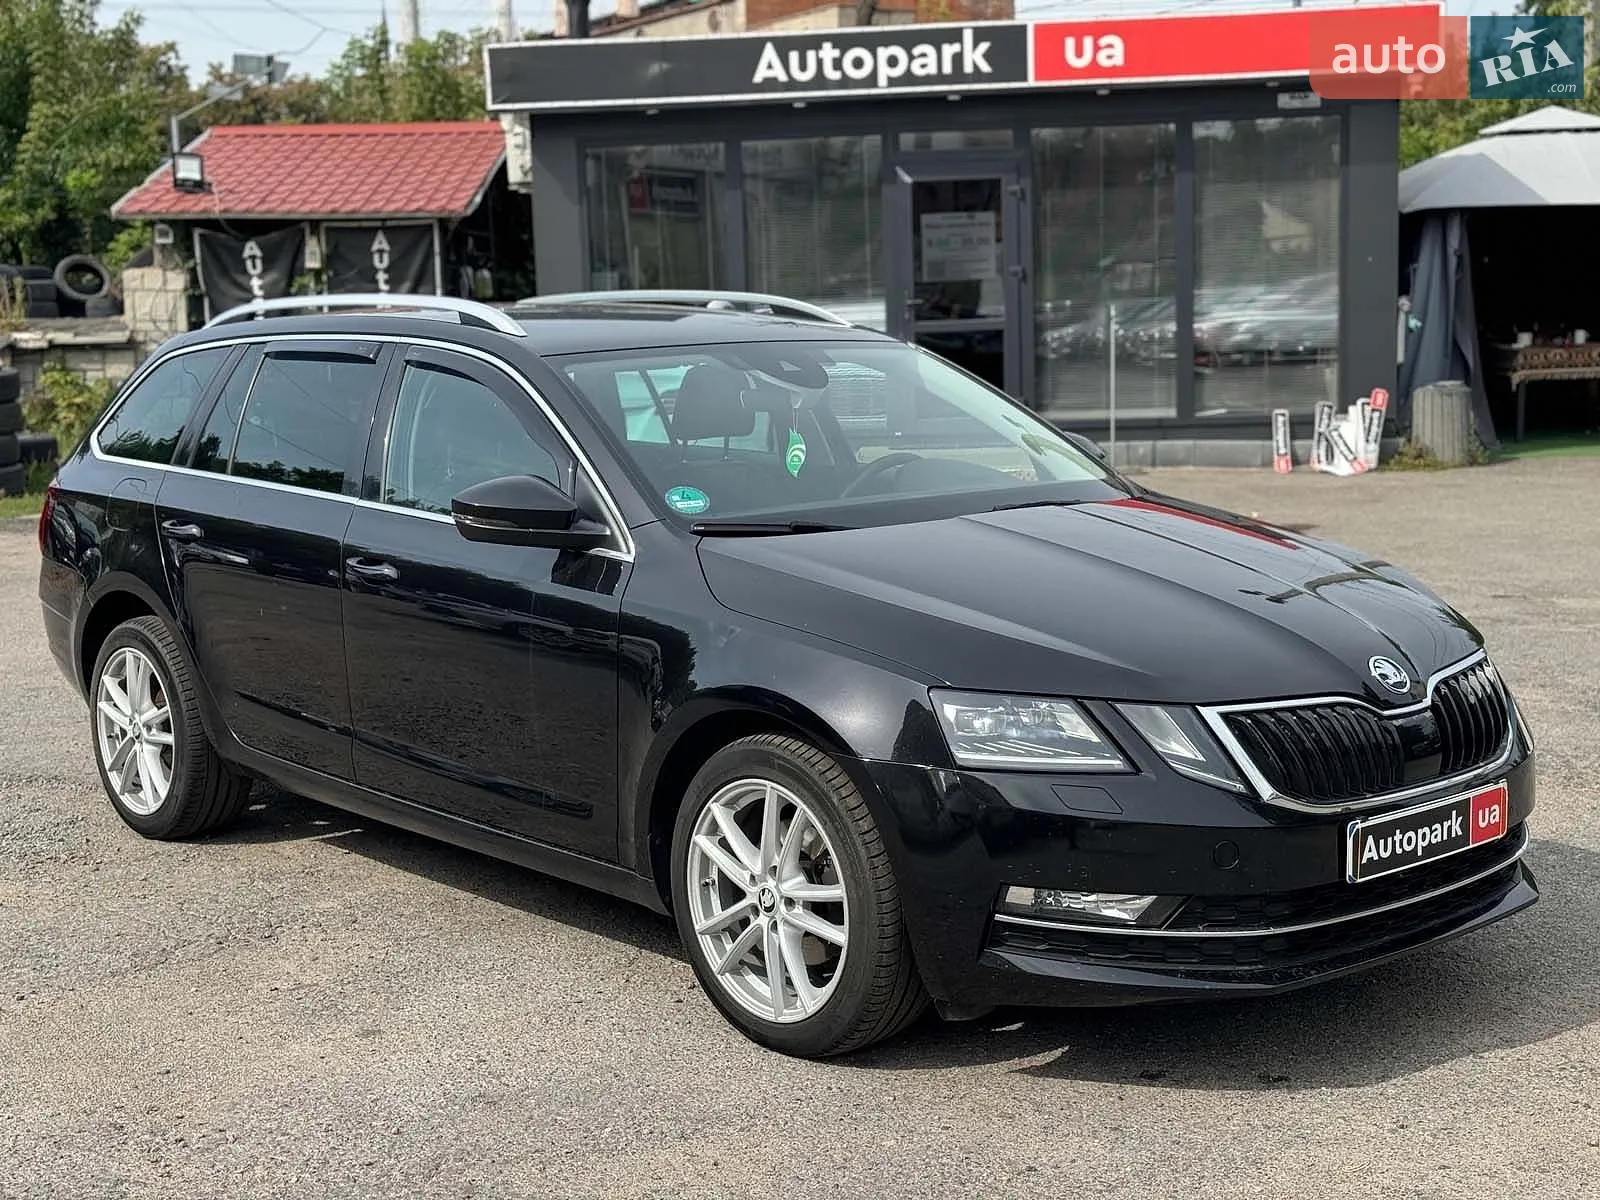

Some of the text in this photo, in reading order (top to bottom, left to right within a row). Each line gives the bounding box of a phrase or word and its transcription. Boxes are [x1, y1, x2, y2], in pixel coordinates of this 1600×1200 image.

[752, 28, 1125, 88] Autopark ua
[1361, 804, 1500, 864] Autopark ua
